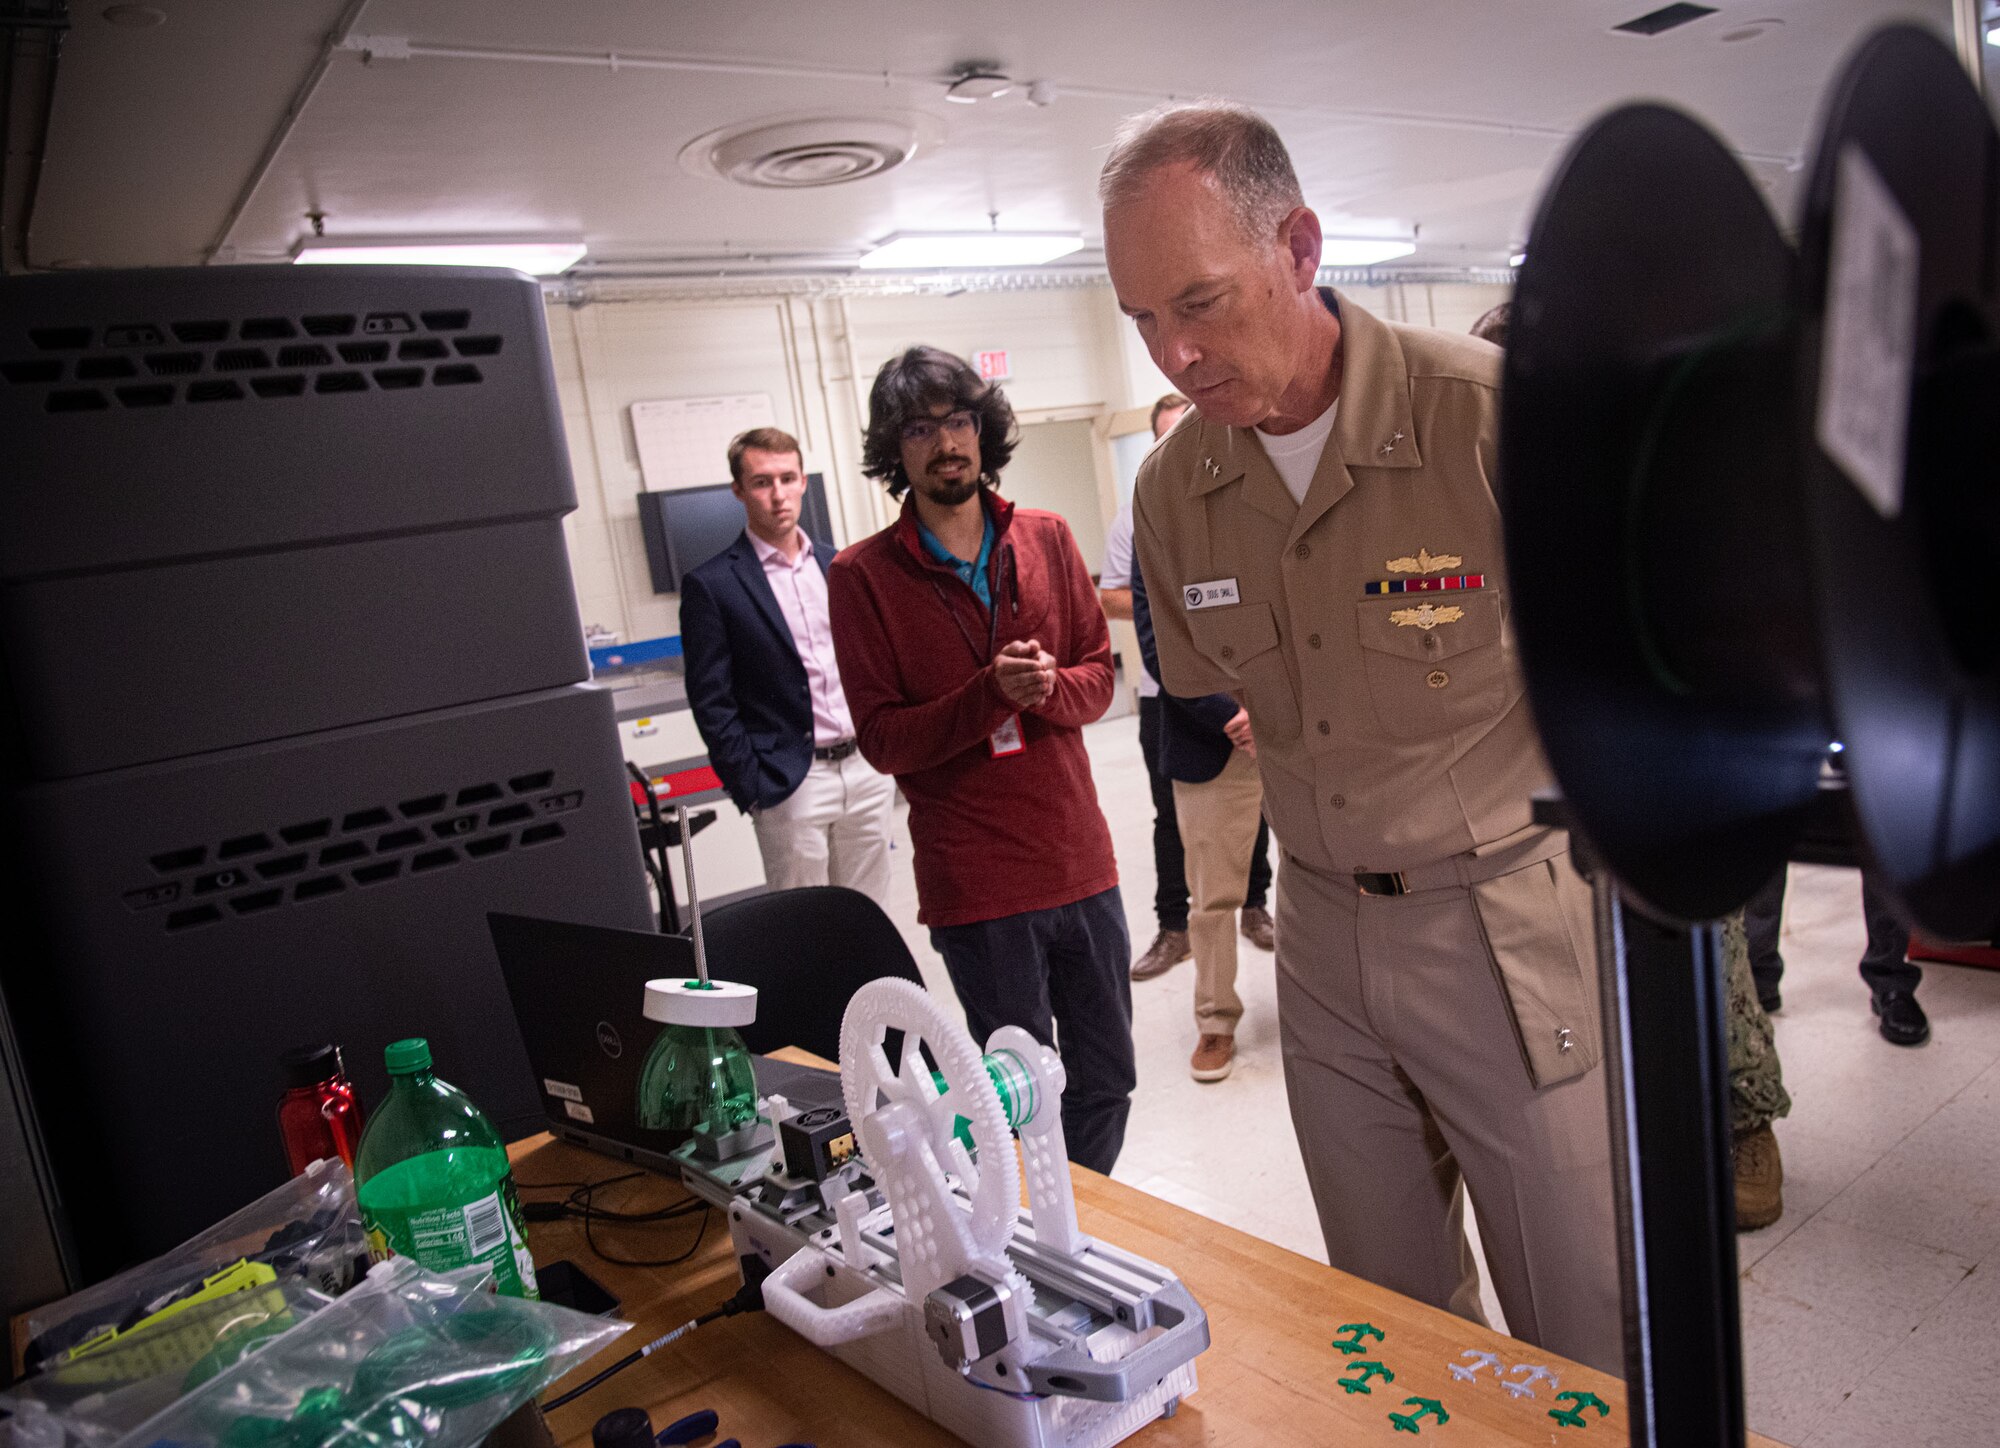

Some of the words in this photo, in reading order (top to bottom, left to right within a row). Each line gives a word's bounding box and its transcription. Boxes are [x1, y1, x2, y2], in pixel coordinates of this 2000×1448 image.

[980, 351, 1008, 379] EXIT
[1206, 589, 1219, 600] DOUG
[1220, 587, 1235, 598] SMALL
[410, 1214, 441, 1226] Nutrition
[441, 1209, 461, 1221] Facts
[415, 1237, 443, 1249] Calories
